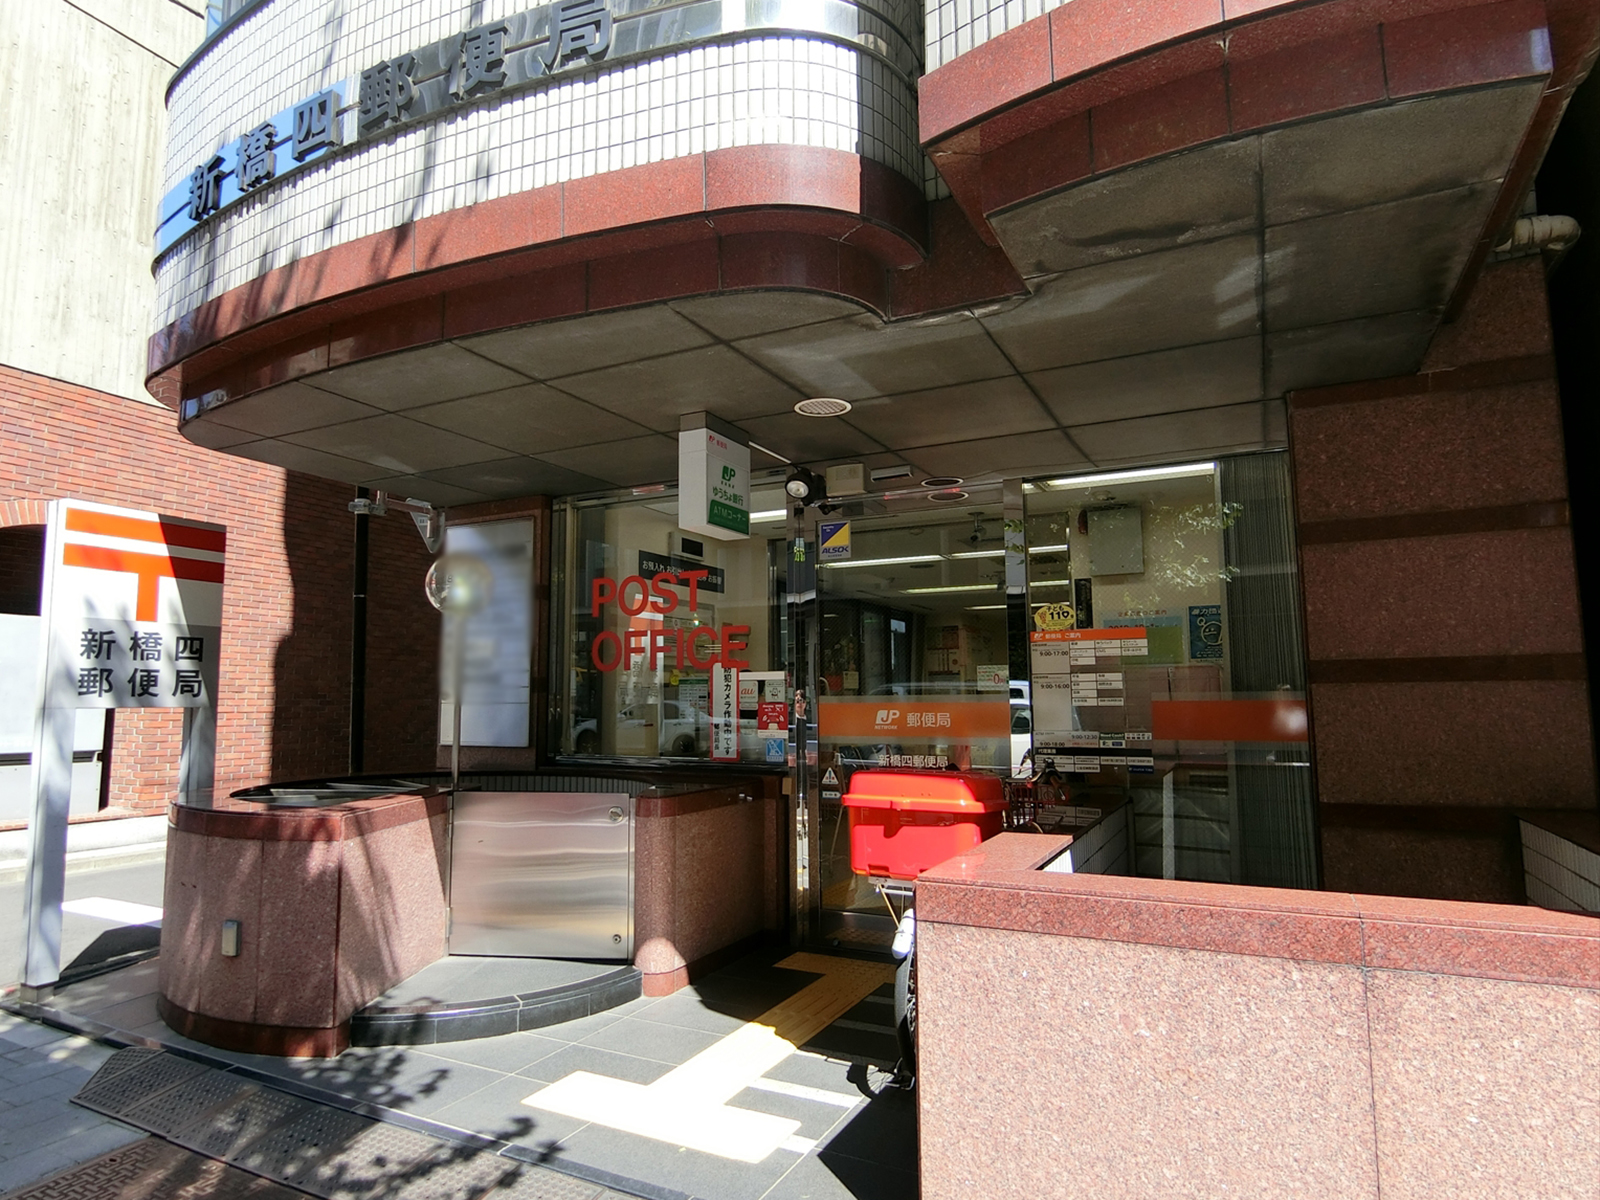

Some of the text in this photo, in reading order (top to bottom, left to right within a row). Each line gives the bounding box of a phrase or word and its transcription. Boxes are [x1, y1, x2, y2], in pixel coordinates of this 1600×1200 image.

[188, 0, 613, 222] 新橋四郵便局
[712, 486, 744, 506] ゆうちょ銀行
[713, 505, 746, 522] ATMコーナー
[821, 546, 849, 555] ALSOK
[591, 569, 708, 618] POST
[79, 628, 205, 662] 新橋四
[591, 625, 749, 673] OFFICE
[77, 667, 203, 698] 郵便局
[906, 712, 951, 728] 郵便局
[878, 754, 949, 768] 新橋四郵便局
